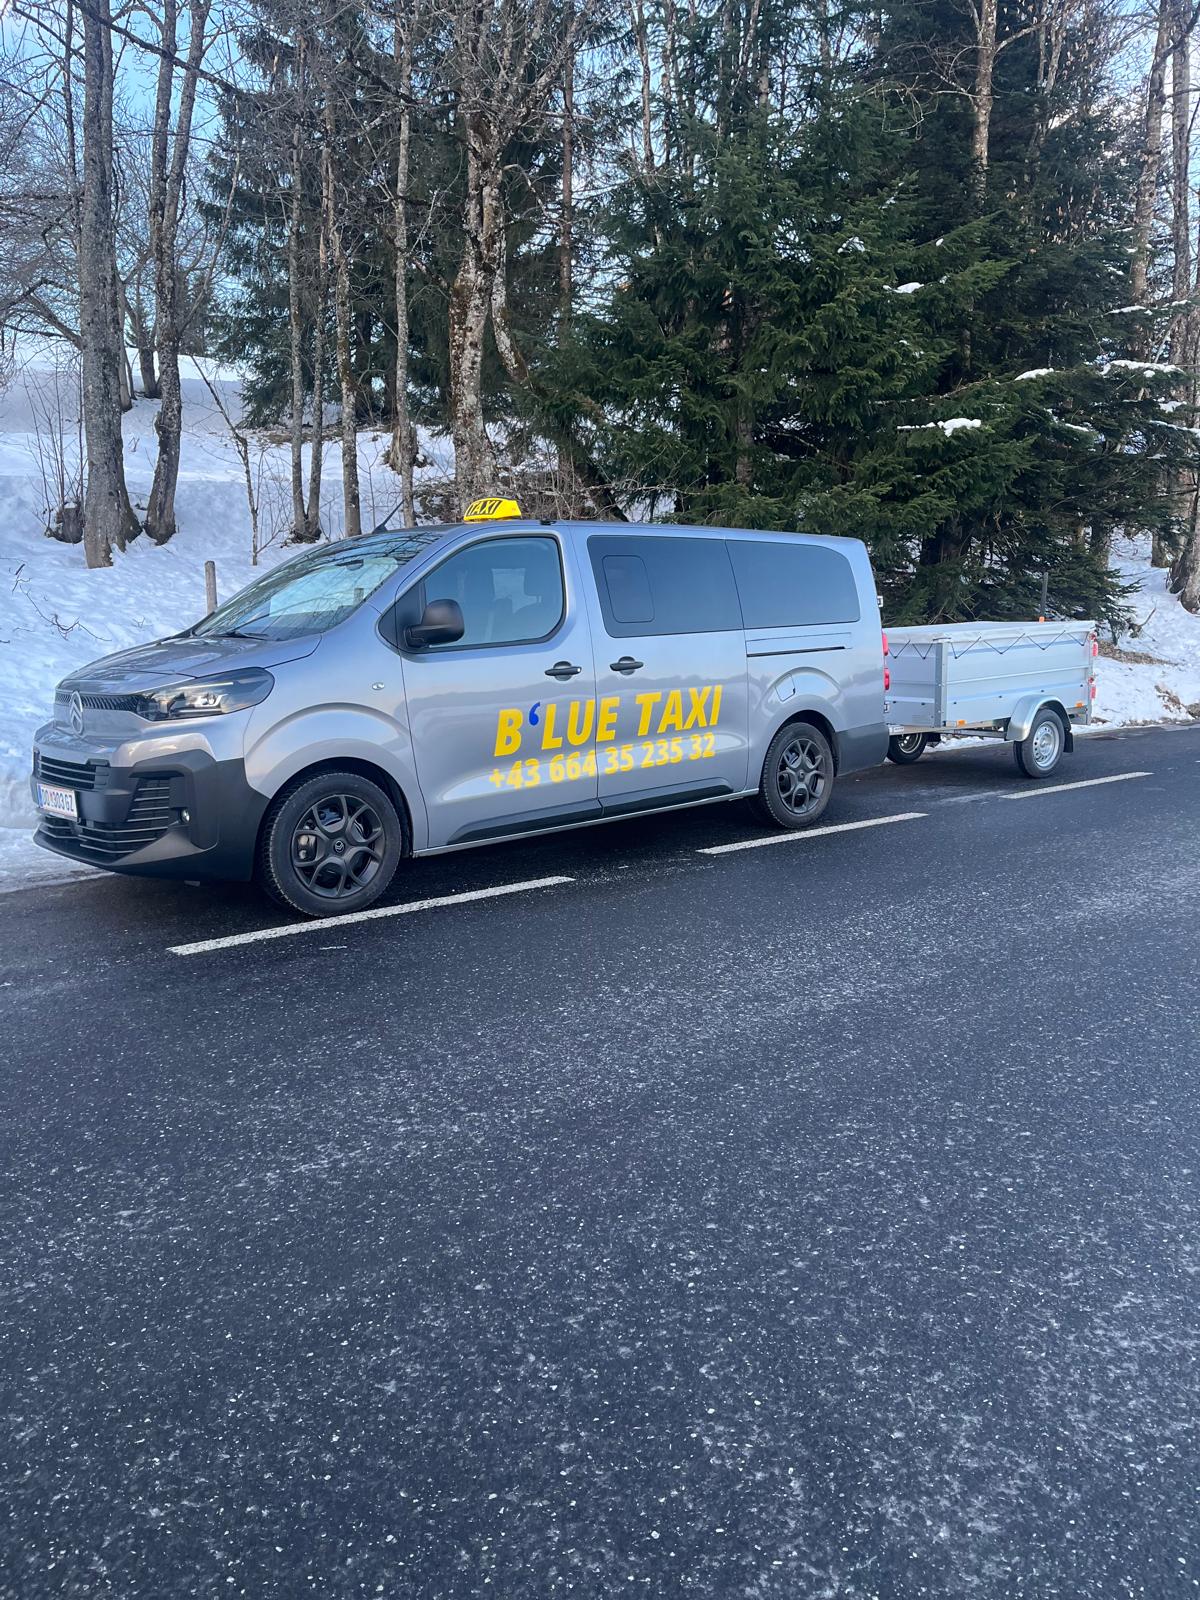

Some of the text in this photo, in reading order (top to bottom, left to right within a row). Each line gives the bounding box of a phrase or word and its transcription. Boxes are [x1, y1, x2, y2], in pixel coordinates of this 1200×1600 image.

[467, 500, 500, 515] TAXI
[635, 684, 723, 737] TAXI
[489, 732, 716, 790] +43 664 35 235 32
